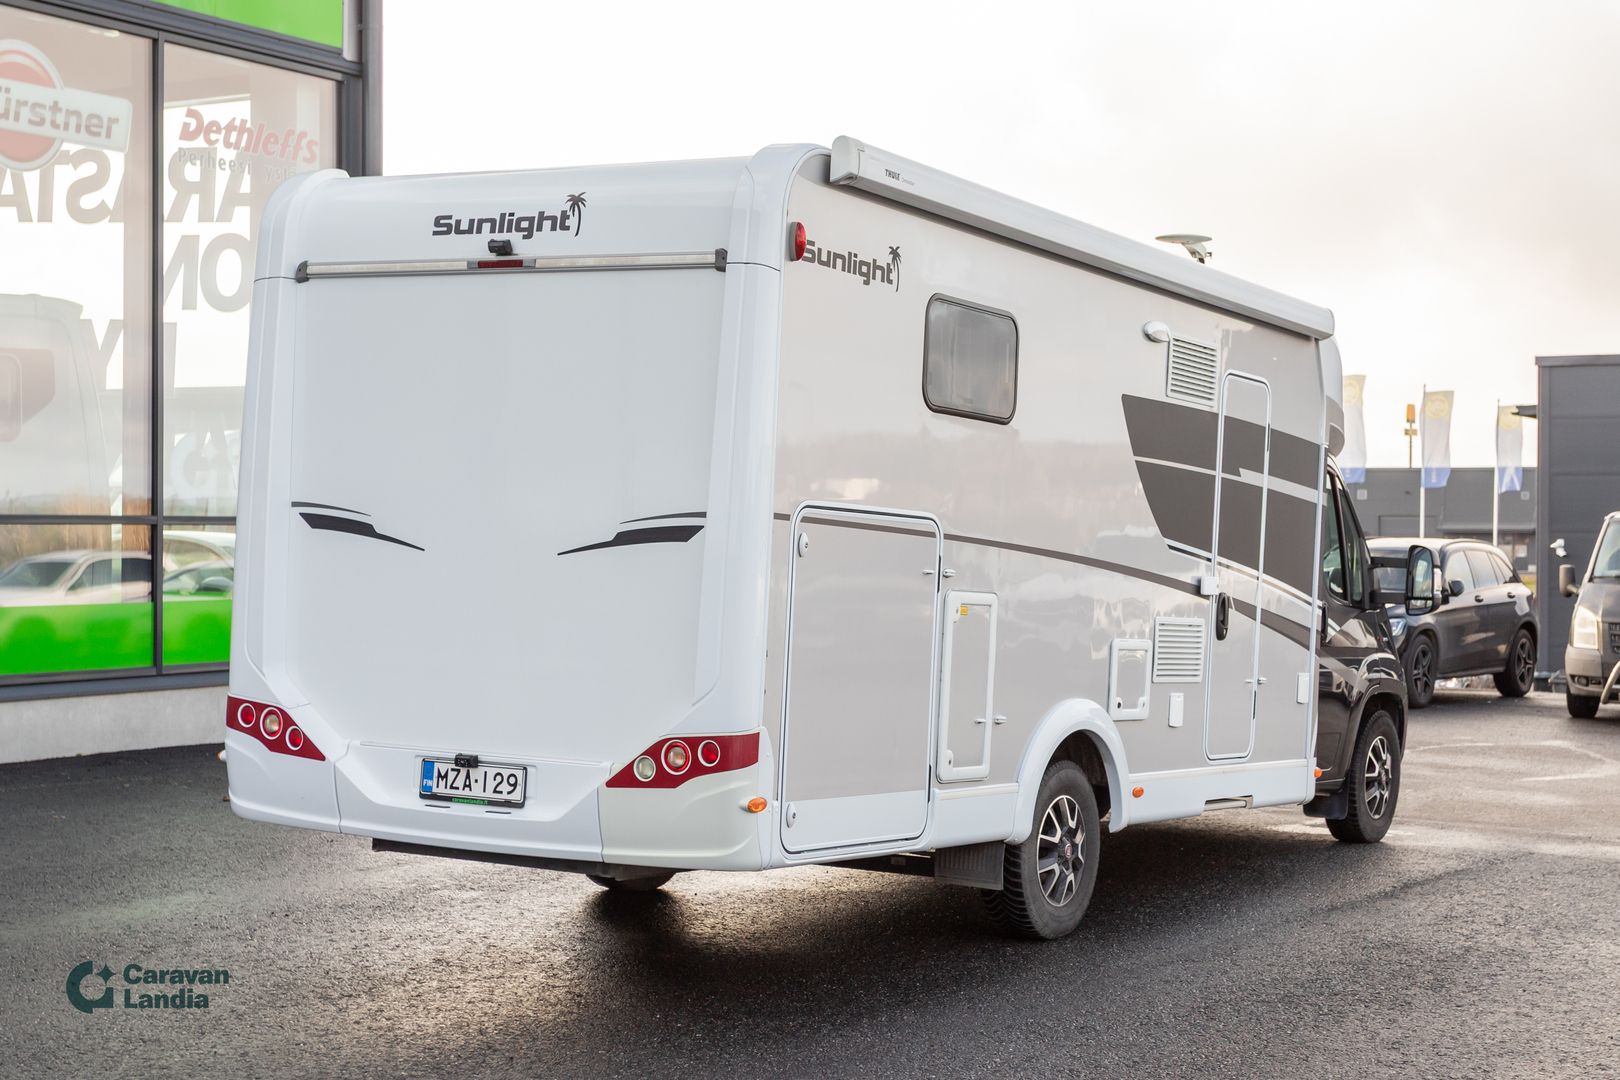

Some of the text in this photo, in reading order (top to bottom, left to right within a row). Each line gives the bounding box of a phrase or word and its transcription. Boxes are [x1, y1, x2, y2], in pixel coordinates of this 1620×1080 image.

[179, 107, 319, 165] Dethleffs
[432, 210, 572, 240] Sunlight
[802, 239, 894, 286] Sunlight
[436, 767, 518, 796] MZA-129
